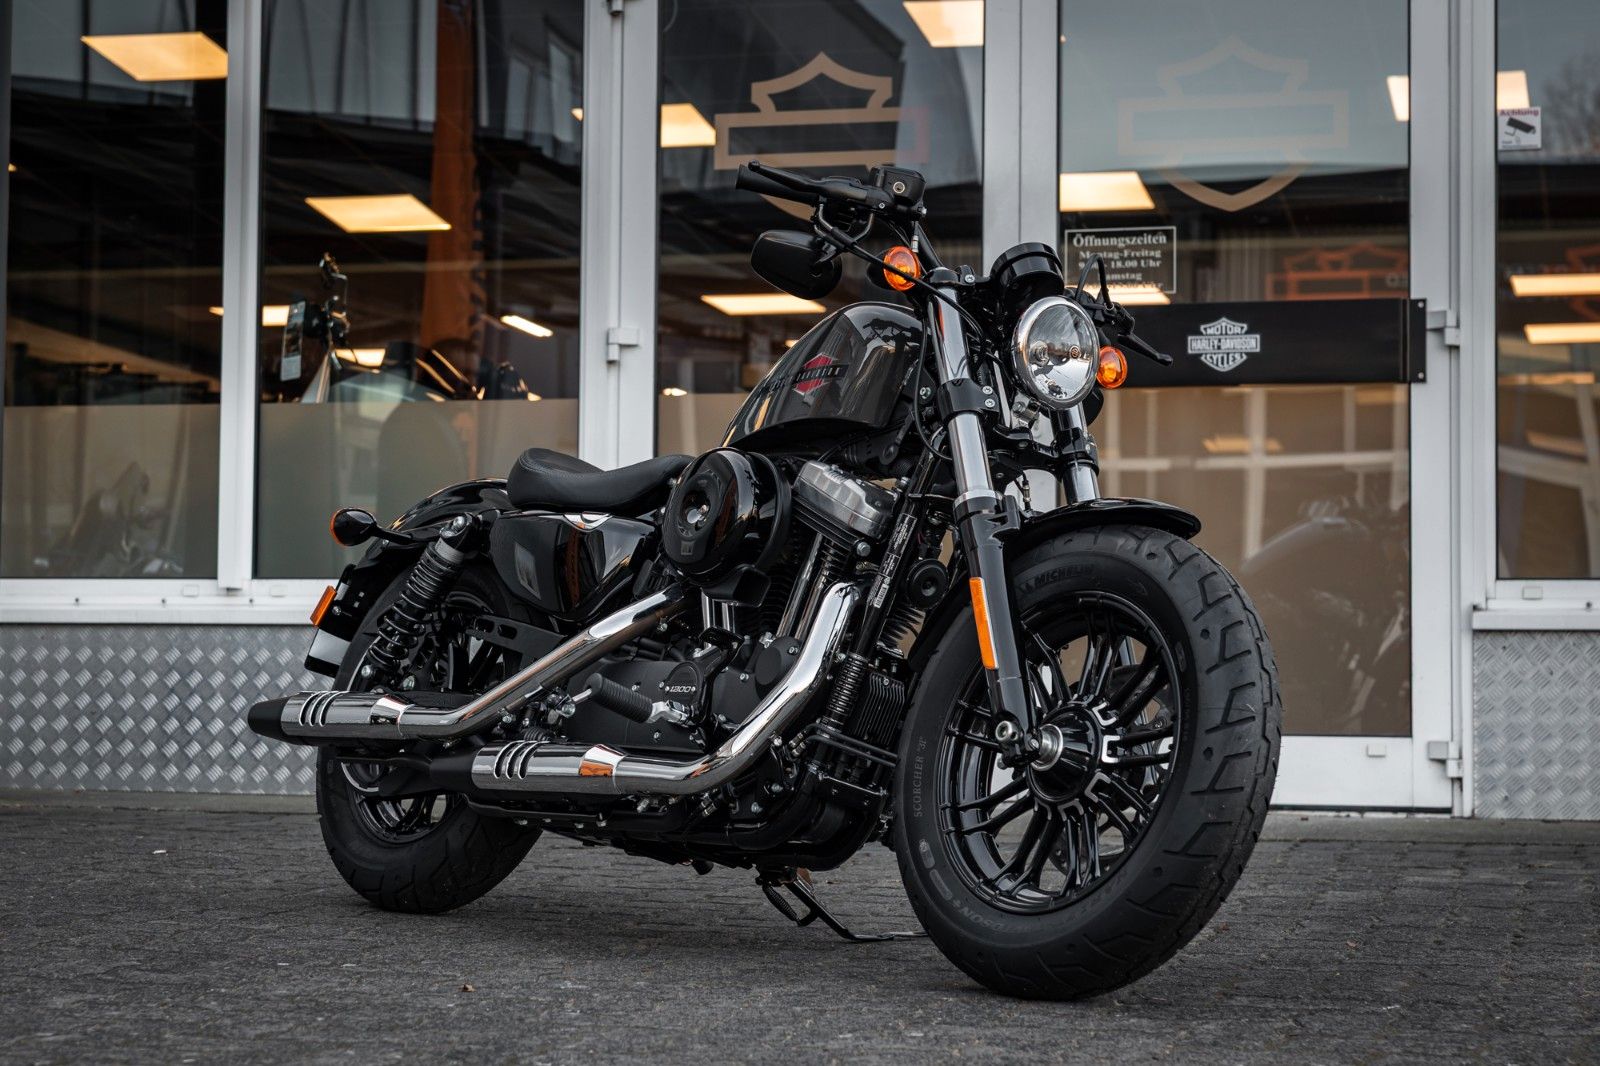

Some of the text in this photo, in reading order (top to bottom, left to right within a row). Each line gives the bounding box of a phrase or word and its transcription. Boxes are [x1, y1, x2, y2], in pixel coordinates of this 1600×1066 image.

[1073, 233, 1167, 248] Öffnungszeiten
[1079, 249, 1162, 260] Mtag-Freitag
[1110, 260, 1138, 270] 18.00
[1140, 259, 1162, 269] Uhr
[1098, 272, 1142, 281] amstag
[1206, 322, 1242, 335] MOTOR
[1191, 337, 1257, 351] HARLEY-DAVIDSON
[1206, 352, 1242, 368] CYCLES
[1034, 564, 1094, 585] MICHELIN
[669, 685, 692, 693] 1200
[912, 754, 925, 818] SCORCHER
